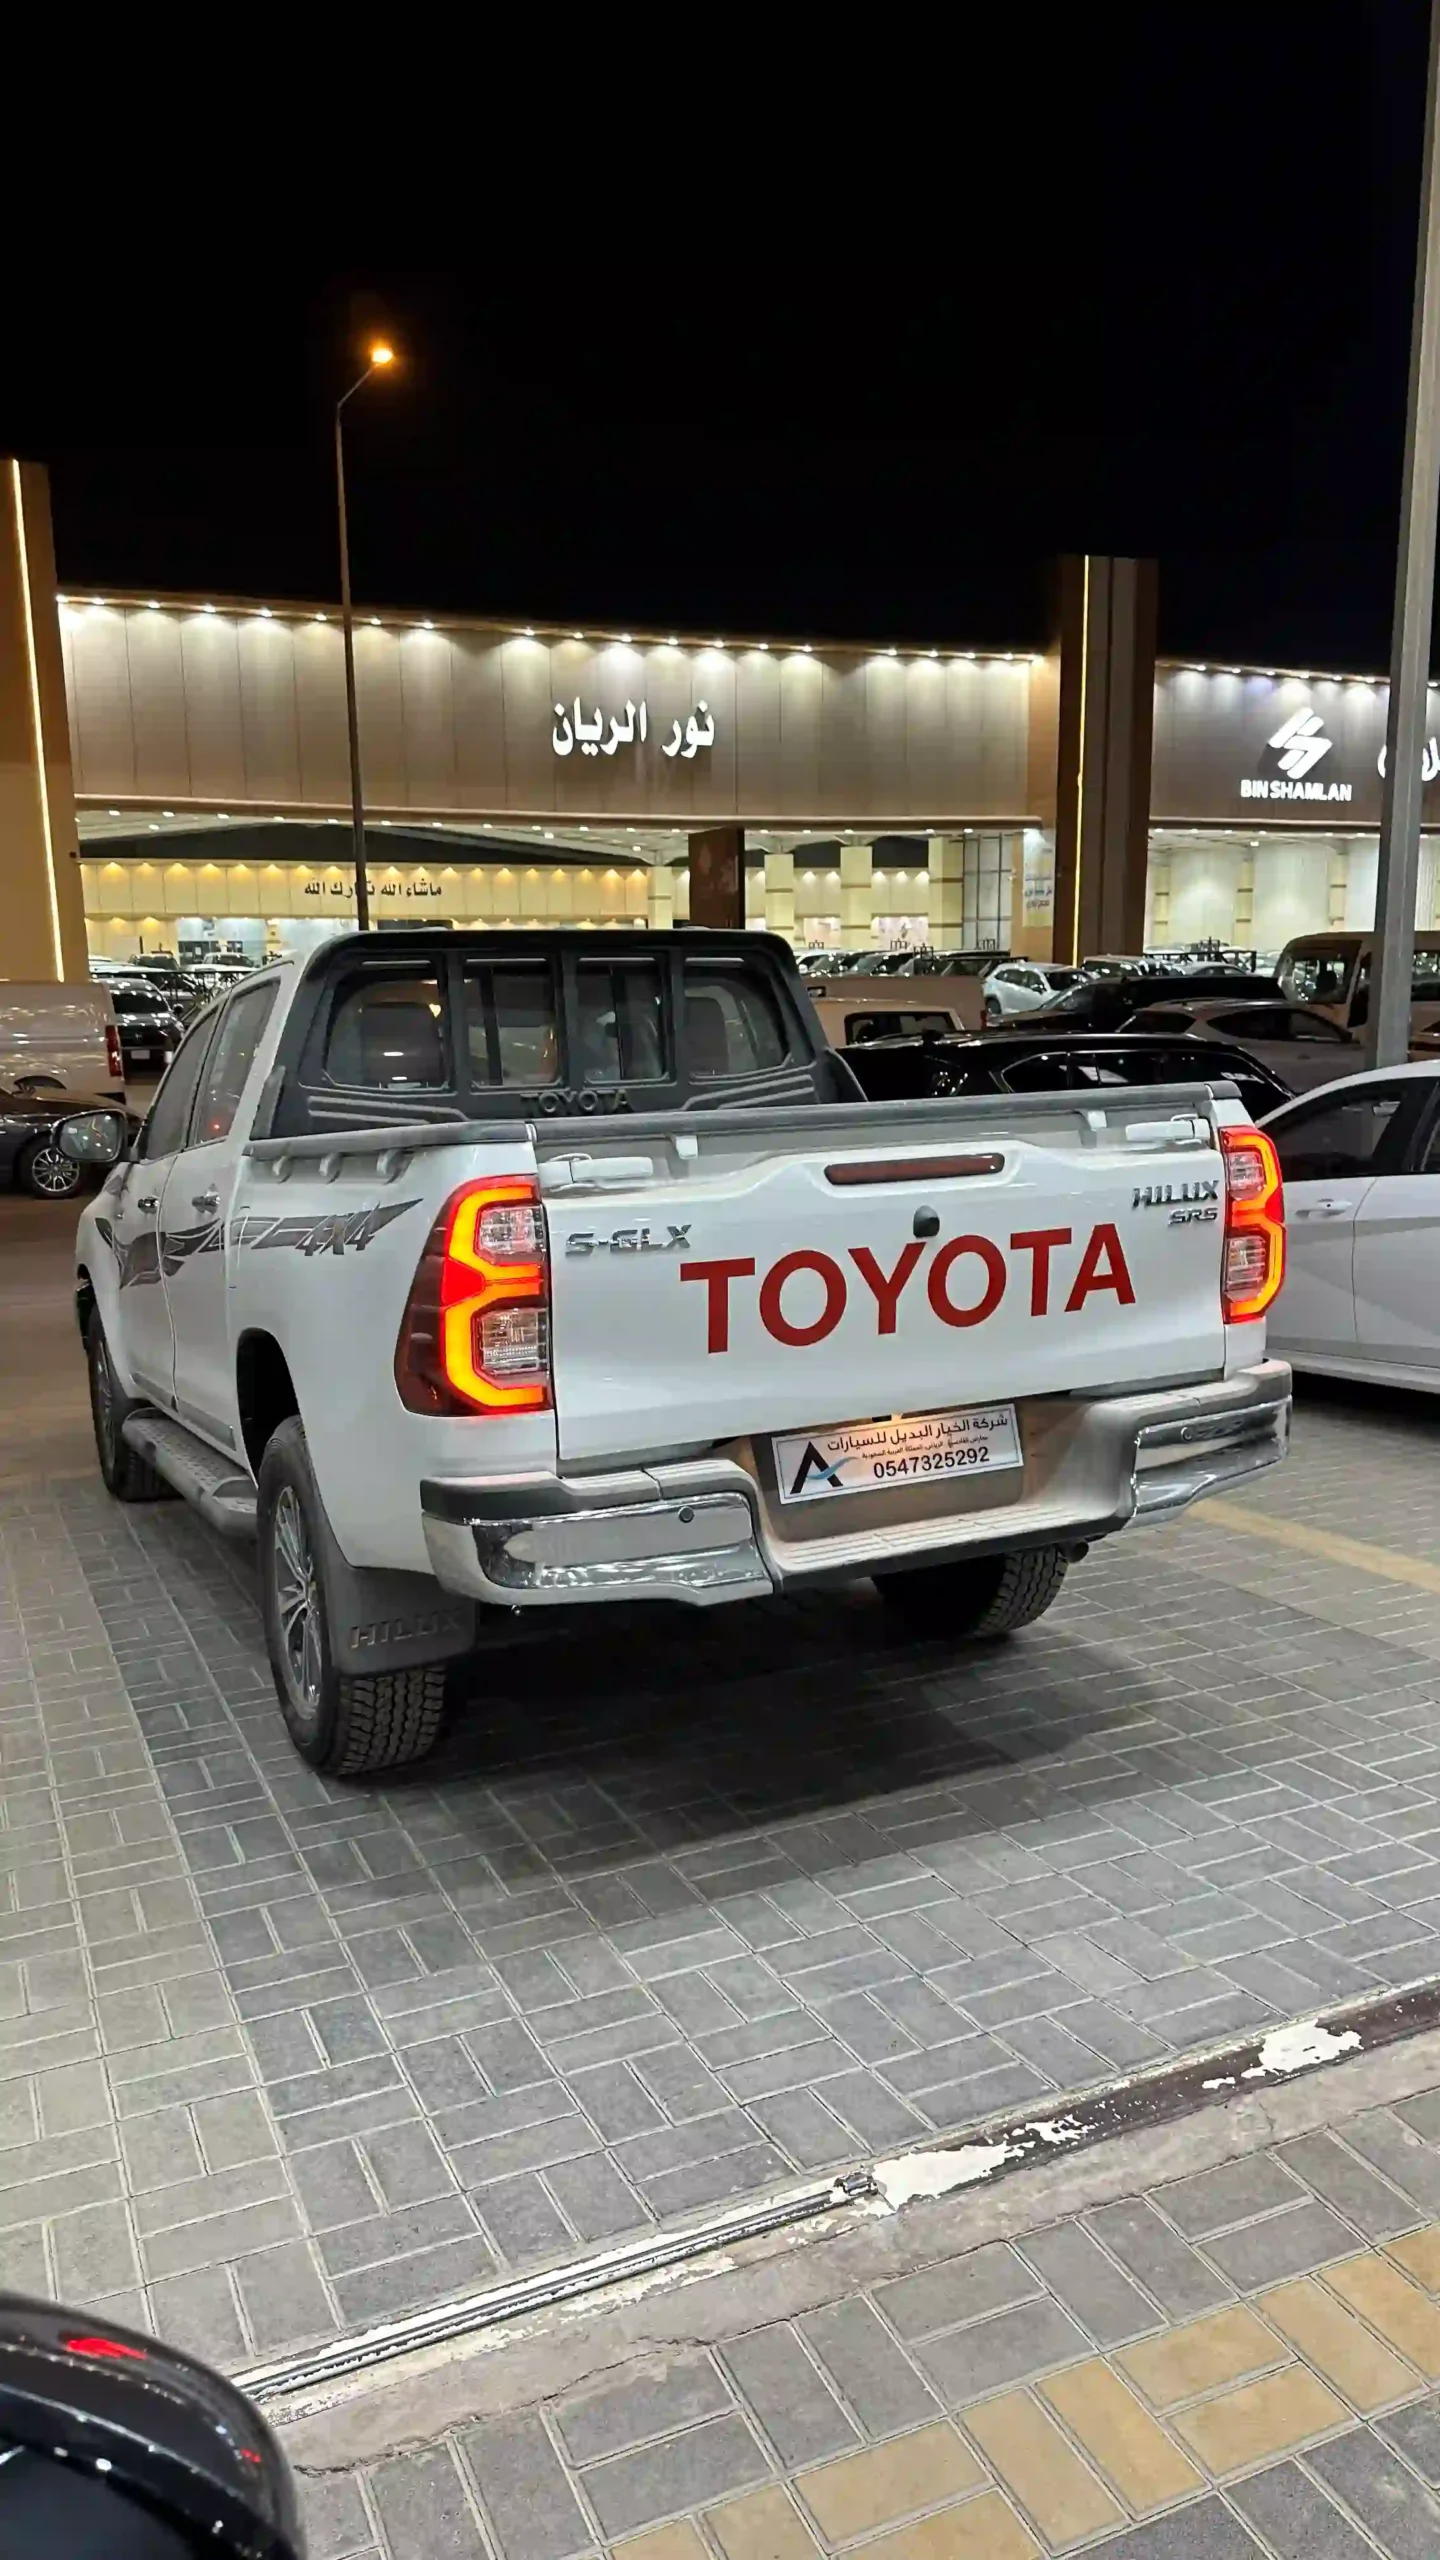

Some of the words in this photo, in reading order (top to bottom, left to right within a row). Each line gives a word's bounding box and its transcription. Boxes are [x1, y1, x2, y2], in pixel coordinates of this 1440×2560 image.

[552, 696, 647, 757] الريان
[662, 699, 715, 759] نور
[1240, 779, 1269, 799] BIN
[1270, 780, 1353, 801] SHAMLAN
[304, 877, 326, 895] الله
[380, 879, 402, 896] الله
[406, 877, 442, 898] ماشاء
[519, 1088, 634, 1114] TOYOTA
[1131, 1179, 1220, 1209] HILUX
[680, 1223, 1136, 1354] TOYOTA
[935, 1419, 970, 1439] الخيار
[973, 1413, 1008, 1431] شركة
[827, 1431, 887, 1453] للسيارات
[889, 1424, 933, 1445] البديل
[873, 1446, 990, 1479] 0547325292
[351, 1607, 463, 1649] HILUX
